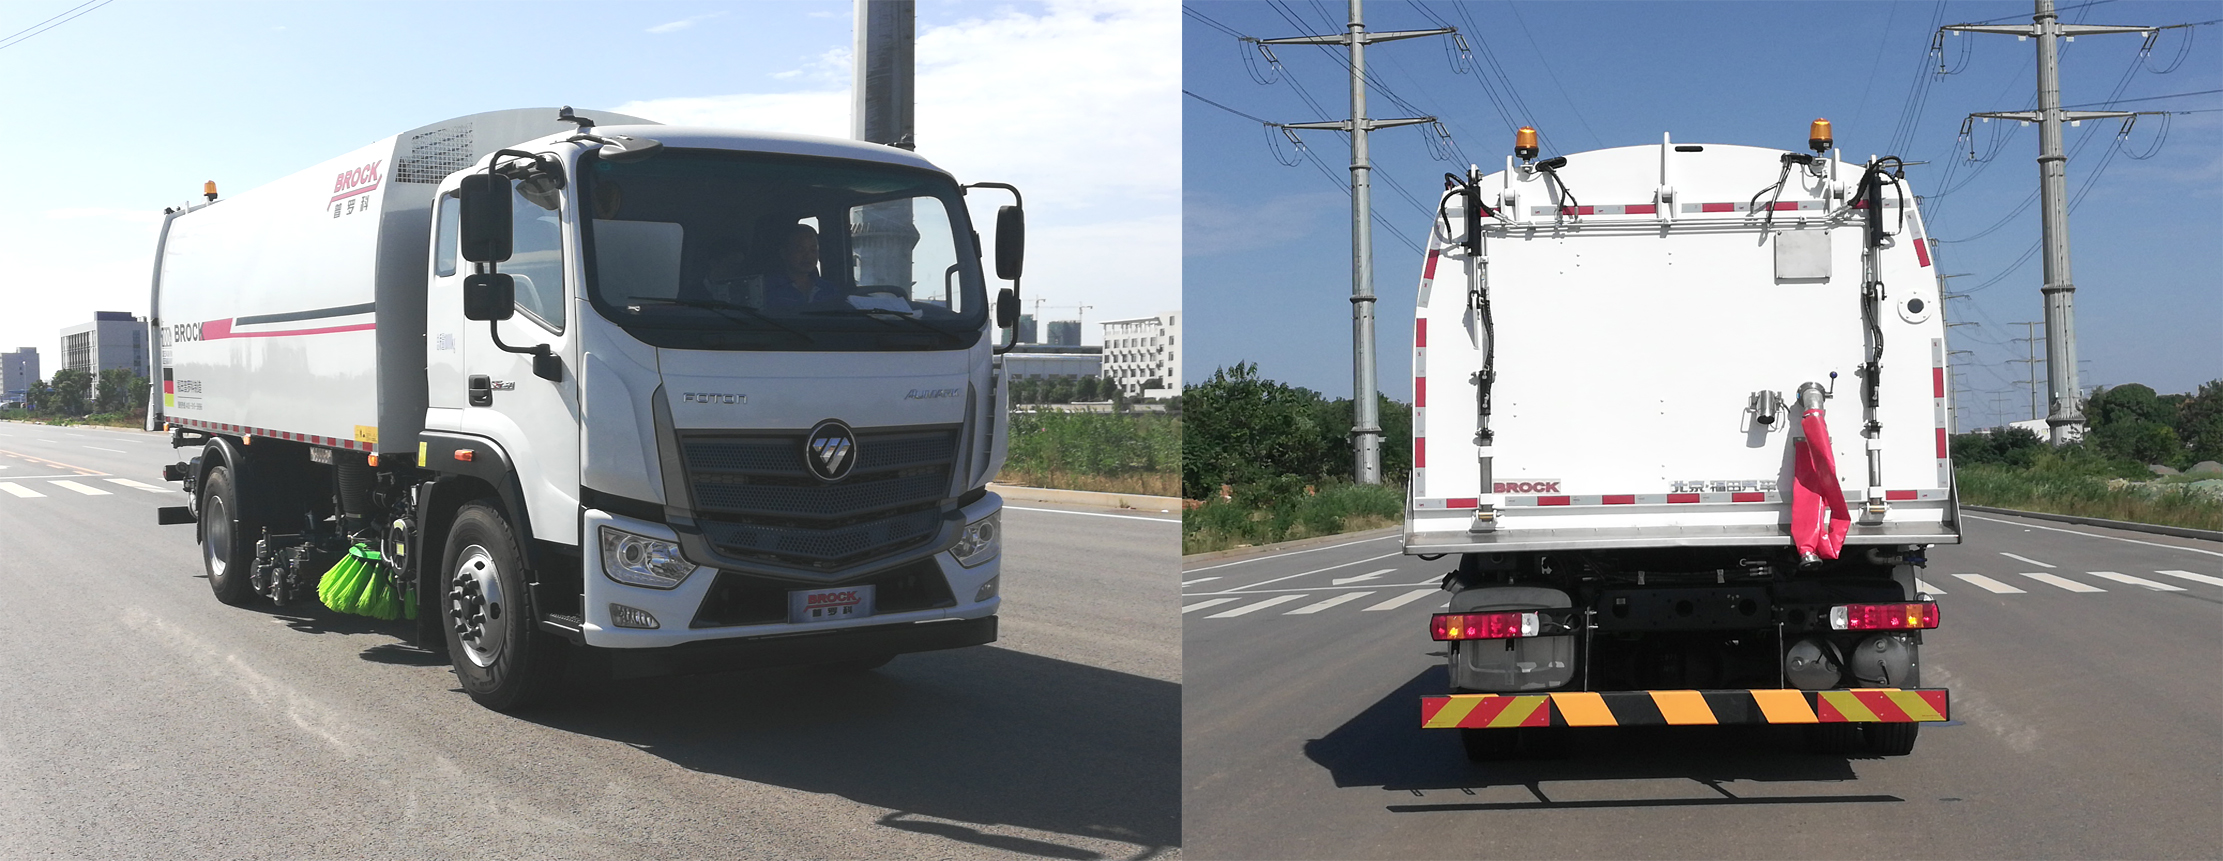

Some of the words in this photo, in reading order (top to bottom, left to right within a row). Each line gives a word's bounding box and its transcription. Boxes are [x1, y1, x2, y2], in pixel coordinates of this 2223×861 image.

[334, 159, 382, 194] BROCK
[174, 322, 205, 343] BROCK
[683, 392, 747, 404] FOTON
[1493, 481, 1560, 494] BROCK
[807, 590, 858, 605] BROCK
